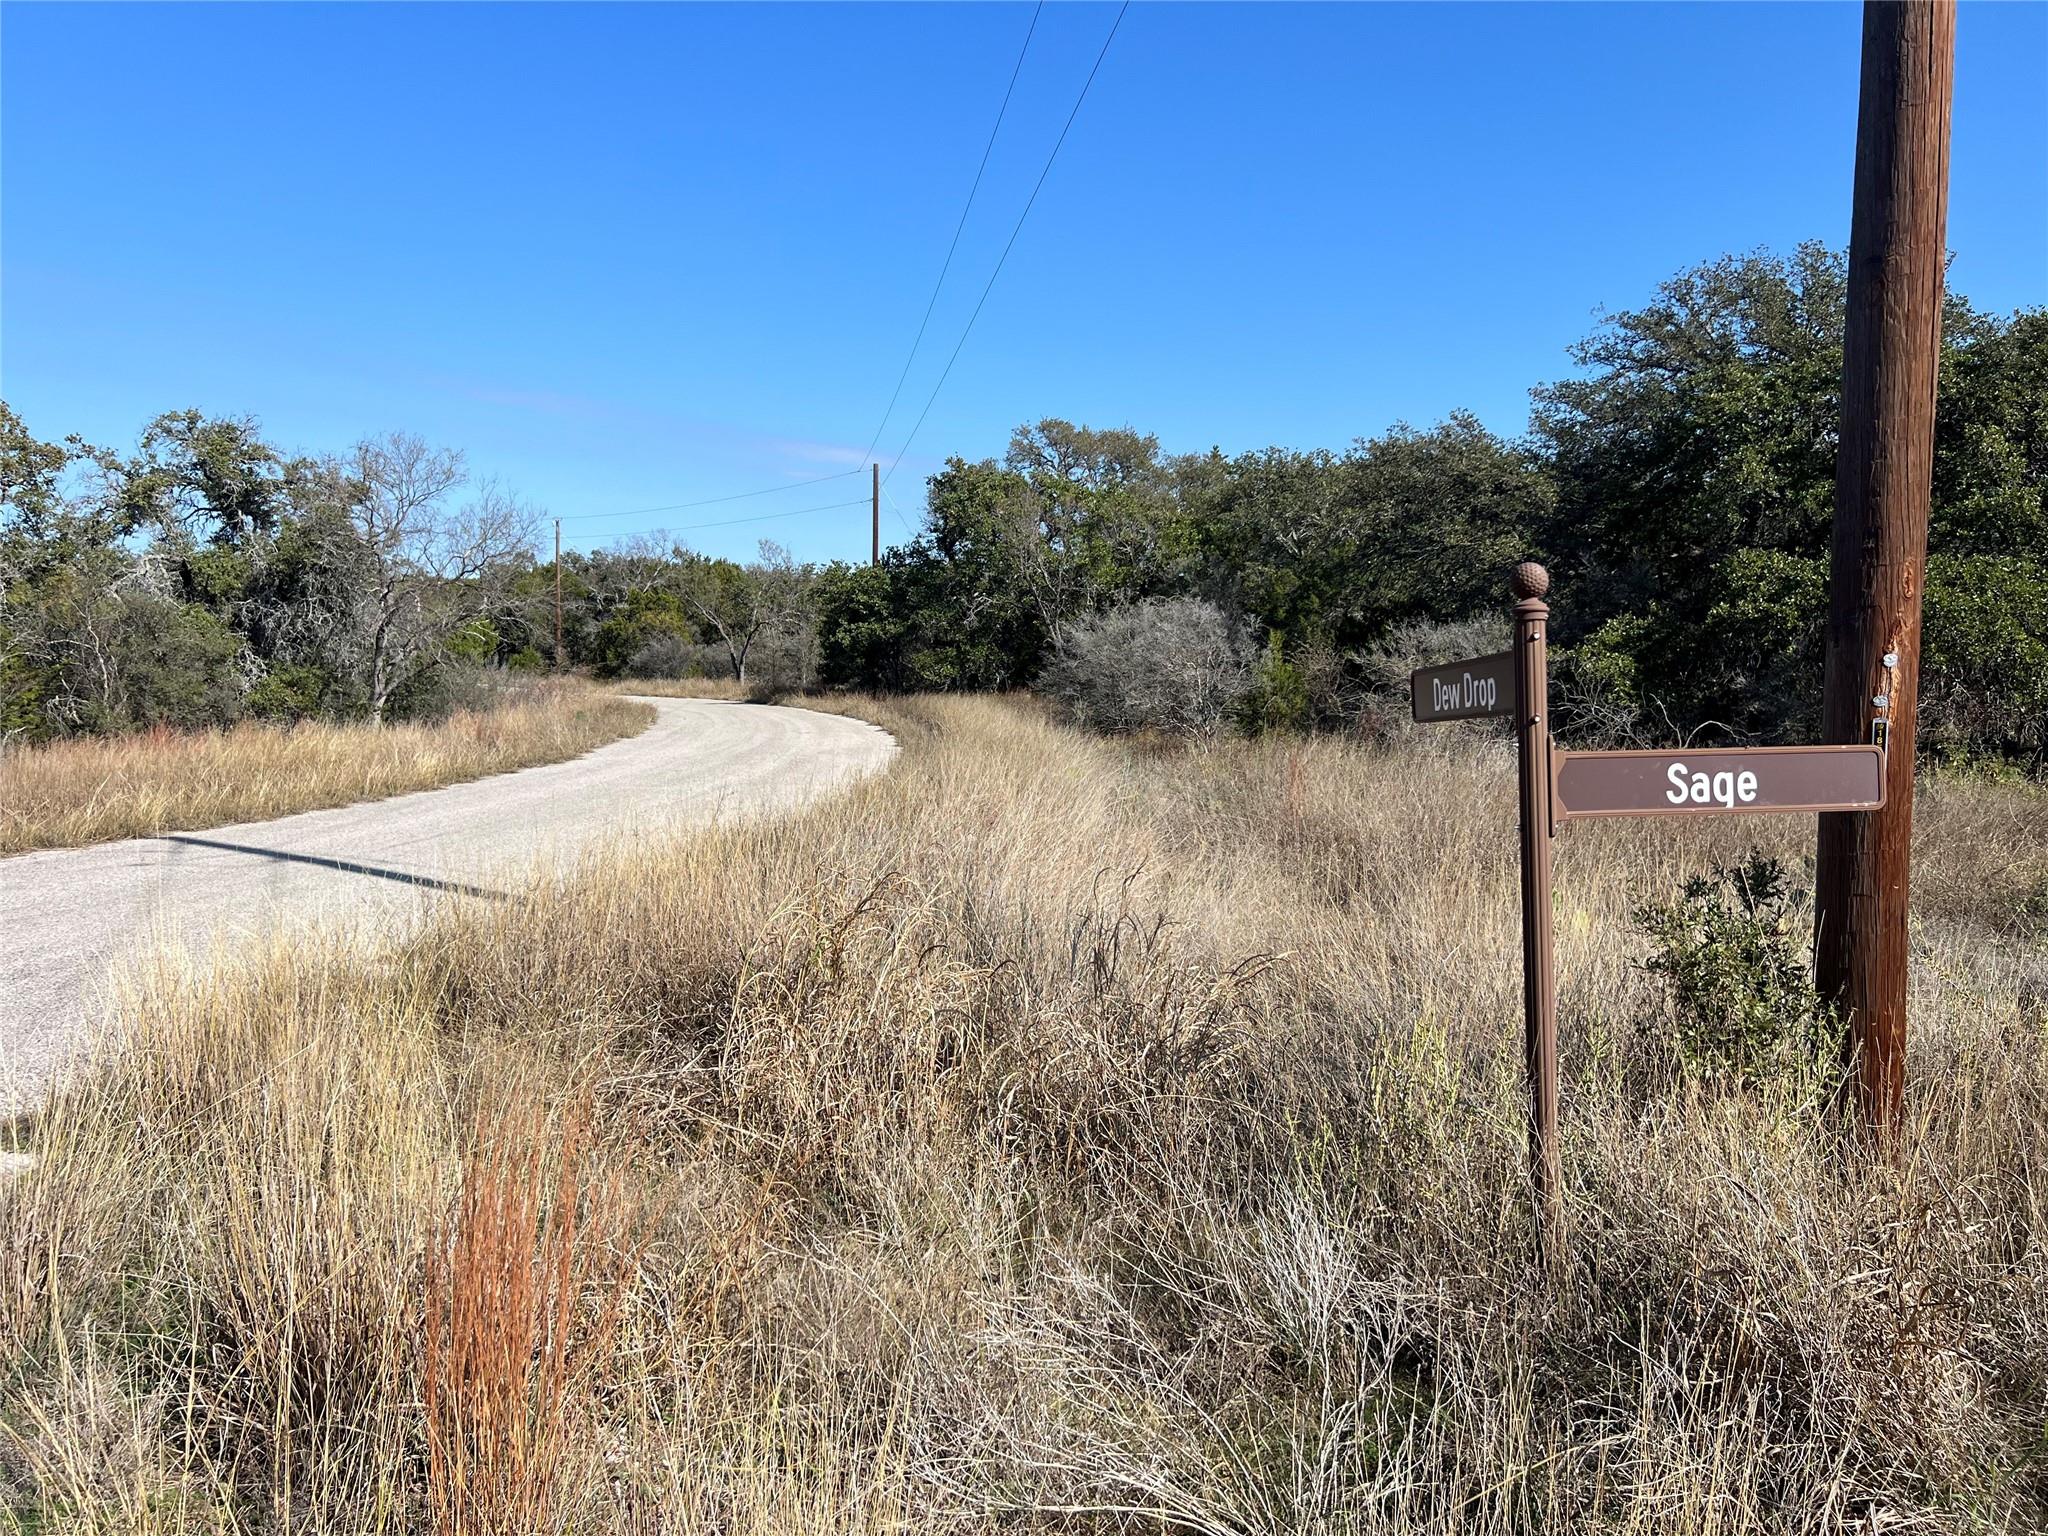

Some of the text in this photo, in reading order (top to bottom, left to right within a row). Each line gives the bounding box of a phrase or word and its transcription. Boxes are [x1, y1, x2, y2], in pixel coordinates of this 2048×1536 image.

[1433, 672, 1496, 712] Dew Drop
[1666, 762, 1757, 808] Sage
